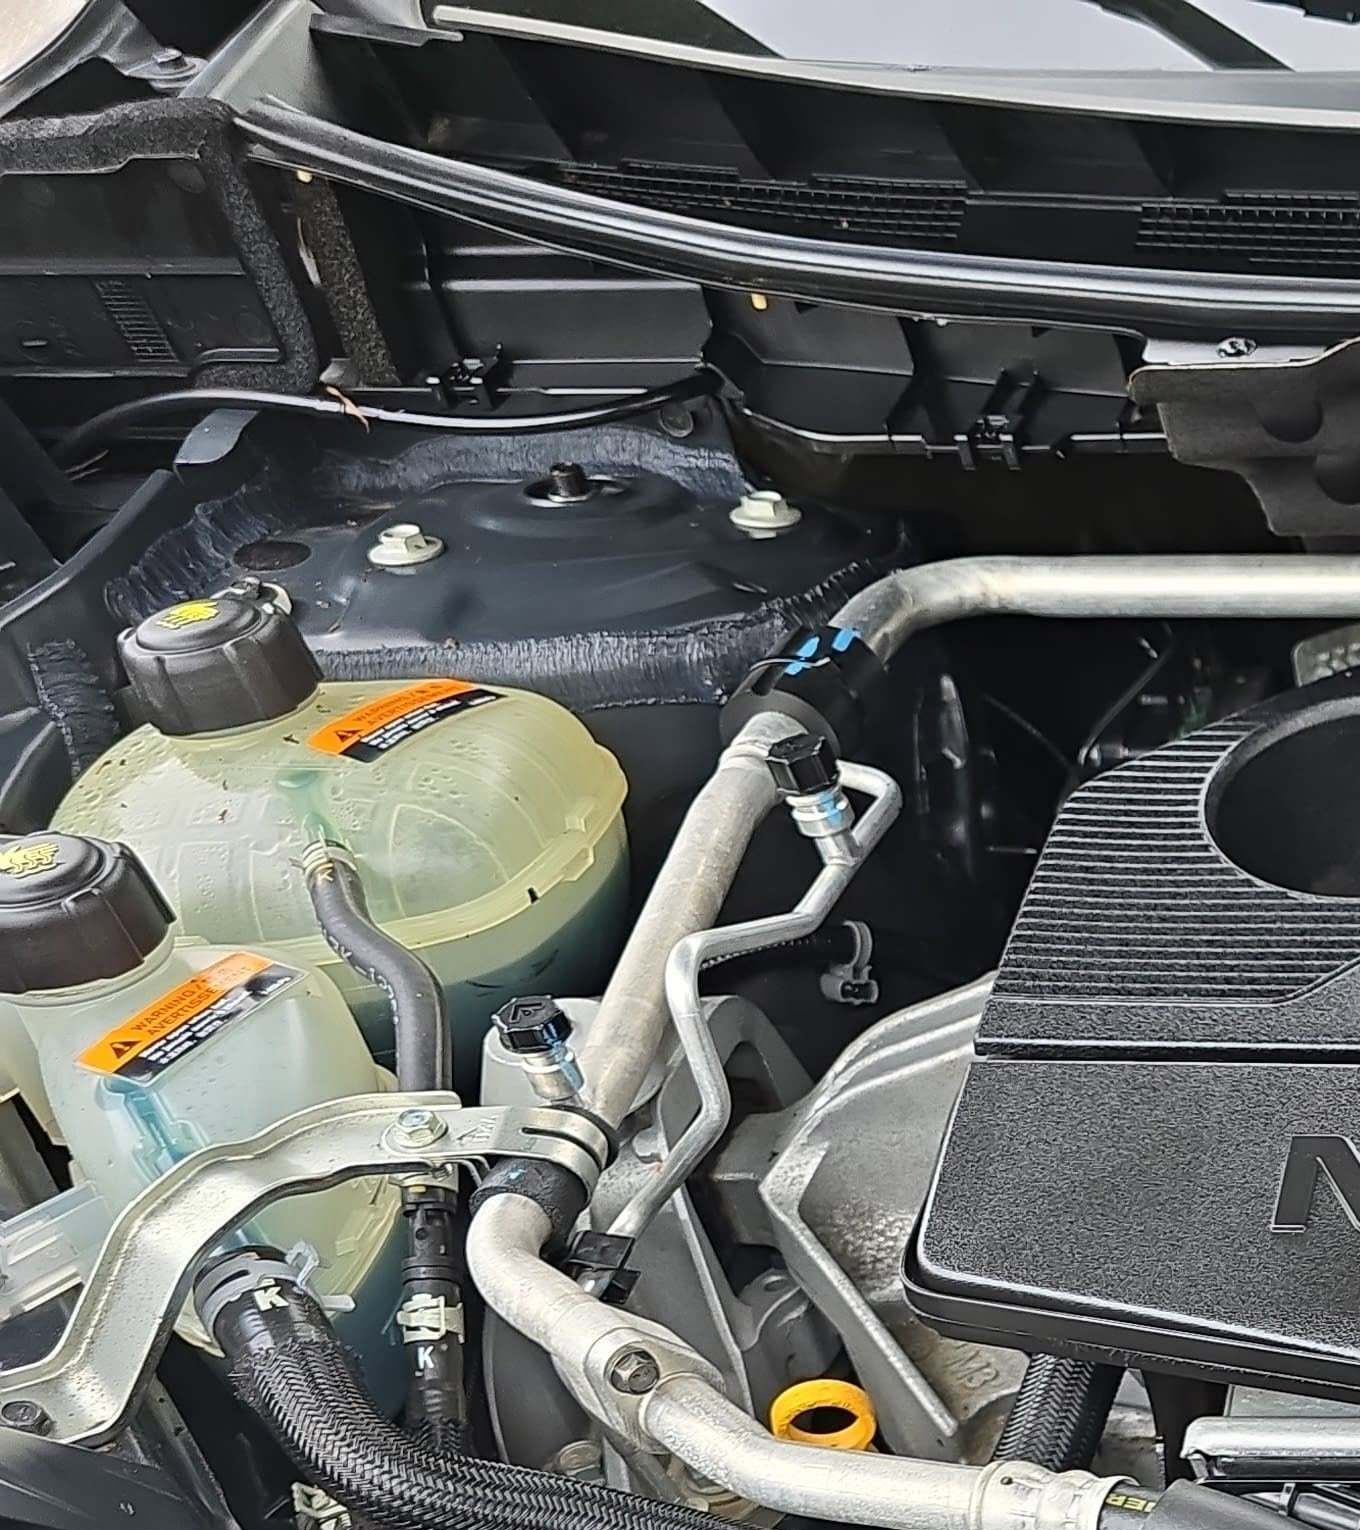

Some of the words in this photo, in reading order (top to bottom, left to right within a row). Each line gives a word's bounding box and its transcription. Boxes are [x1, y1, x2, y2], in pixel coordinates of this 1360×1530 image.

[131, 989, 195, 1031] WARNING
[254, 1286, 289, 1311] K
[417, 1345, 435, 1370] K
